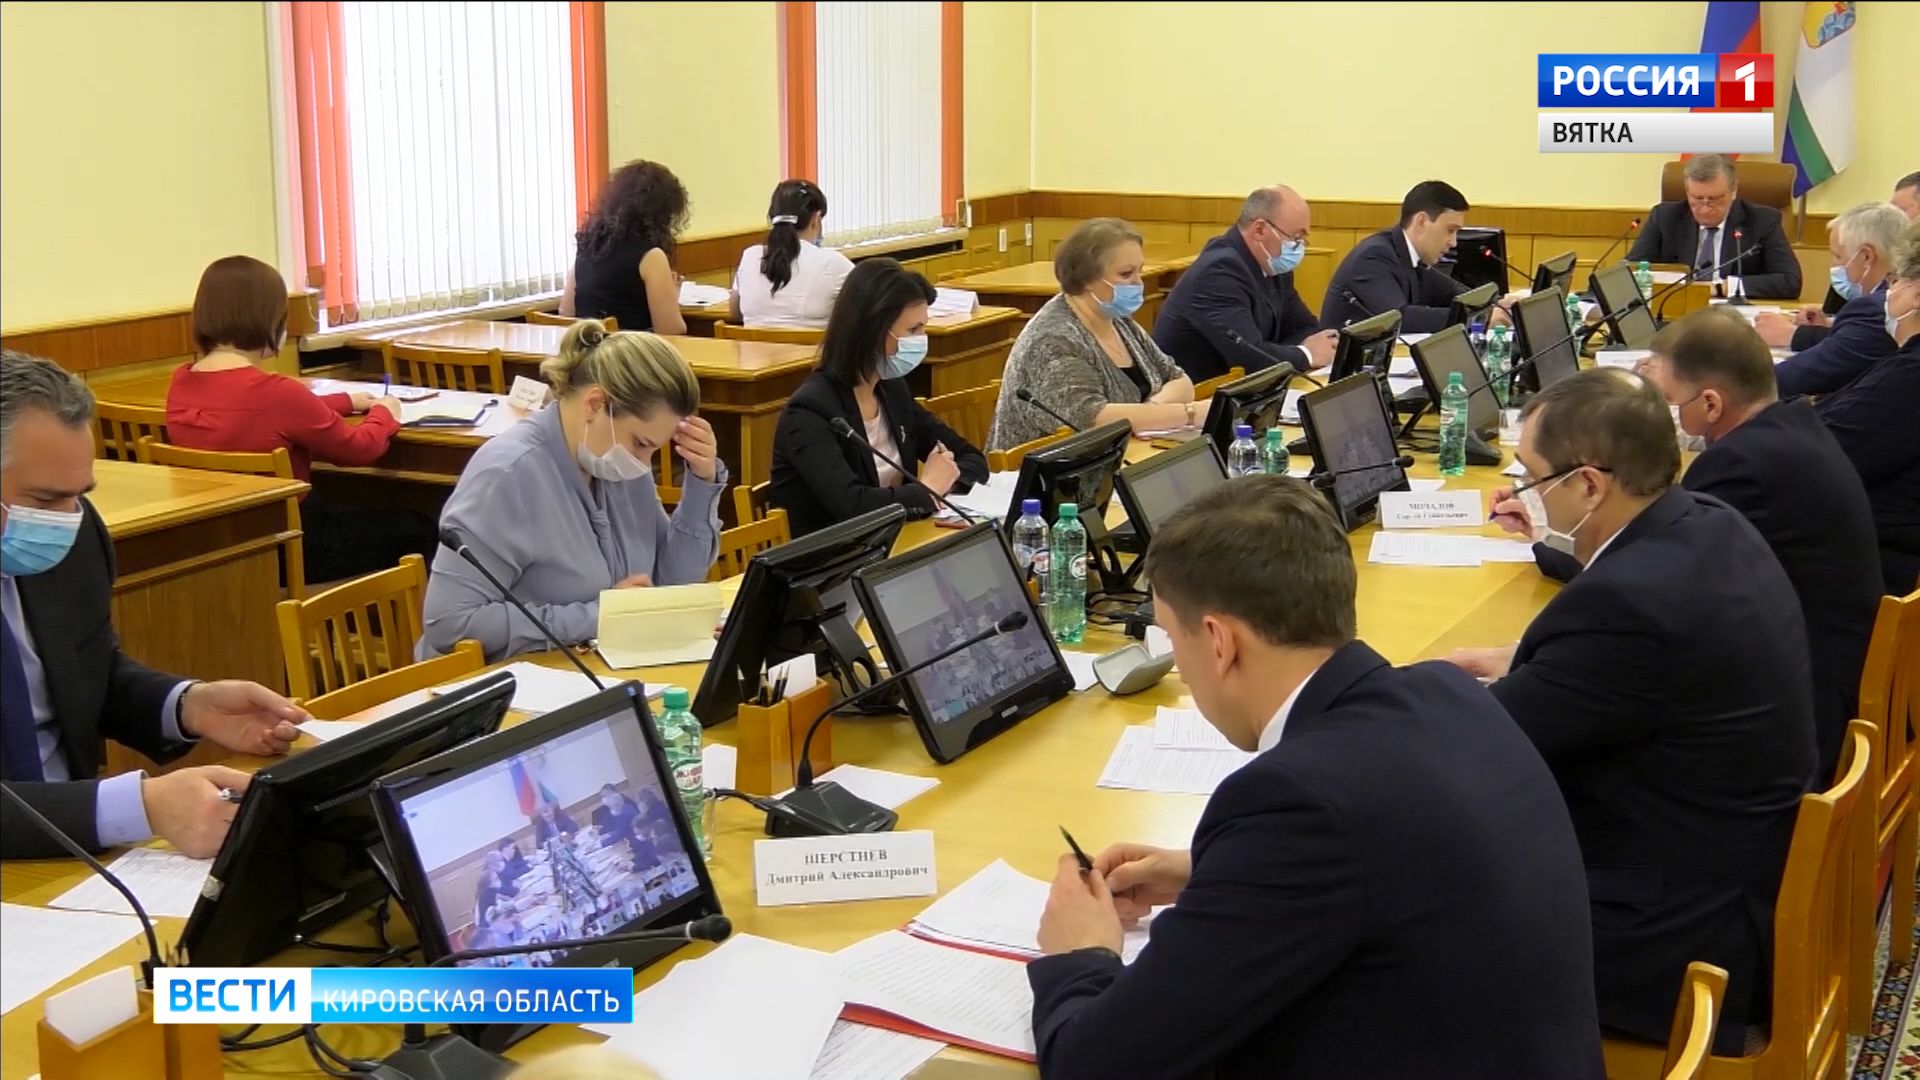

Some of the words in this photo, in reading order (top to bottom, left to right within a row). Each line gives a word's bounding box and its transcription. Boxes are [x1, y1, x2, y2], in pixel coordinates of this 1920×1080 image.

[805, 849, 888, 865] ШЕРСТНЕВ
[766, 871, 825, 886] Дмитрий
[829, 866, 928, 881] Александрович
